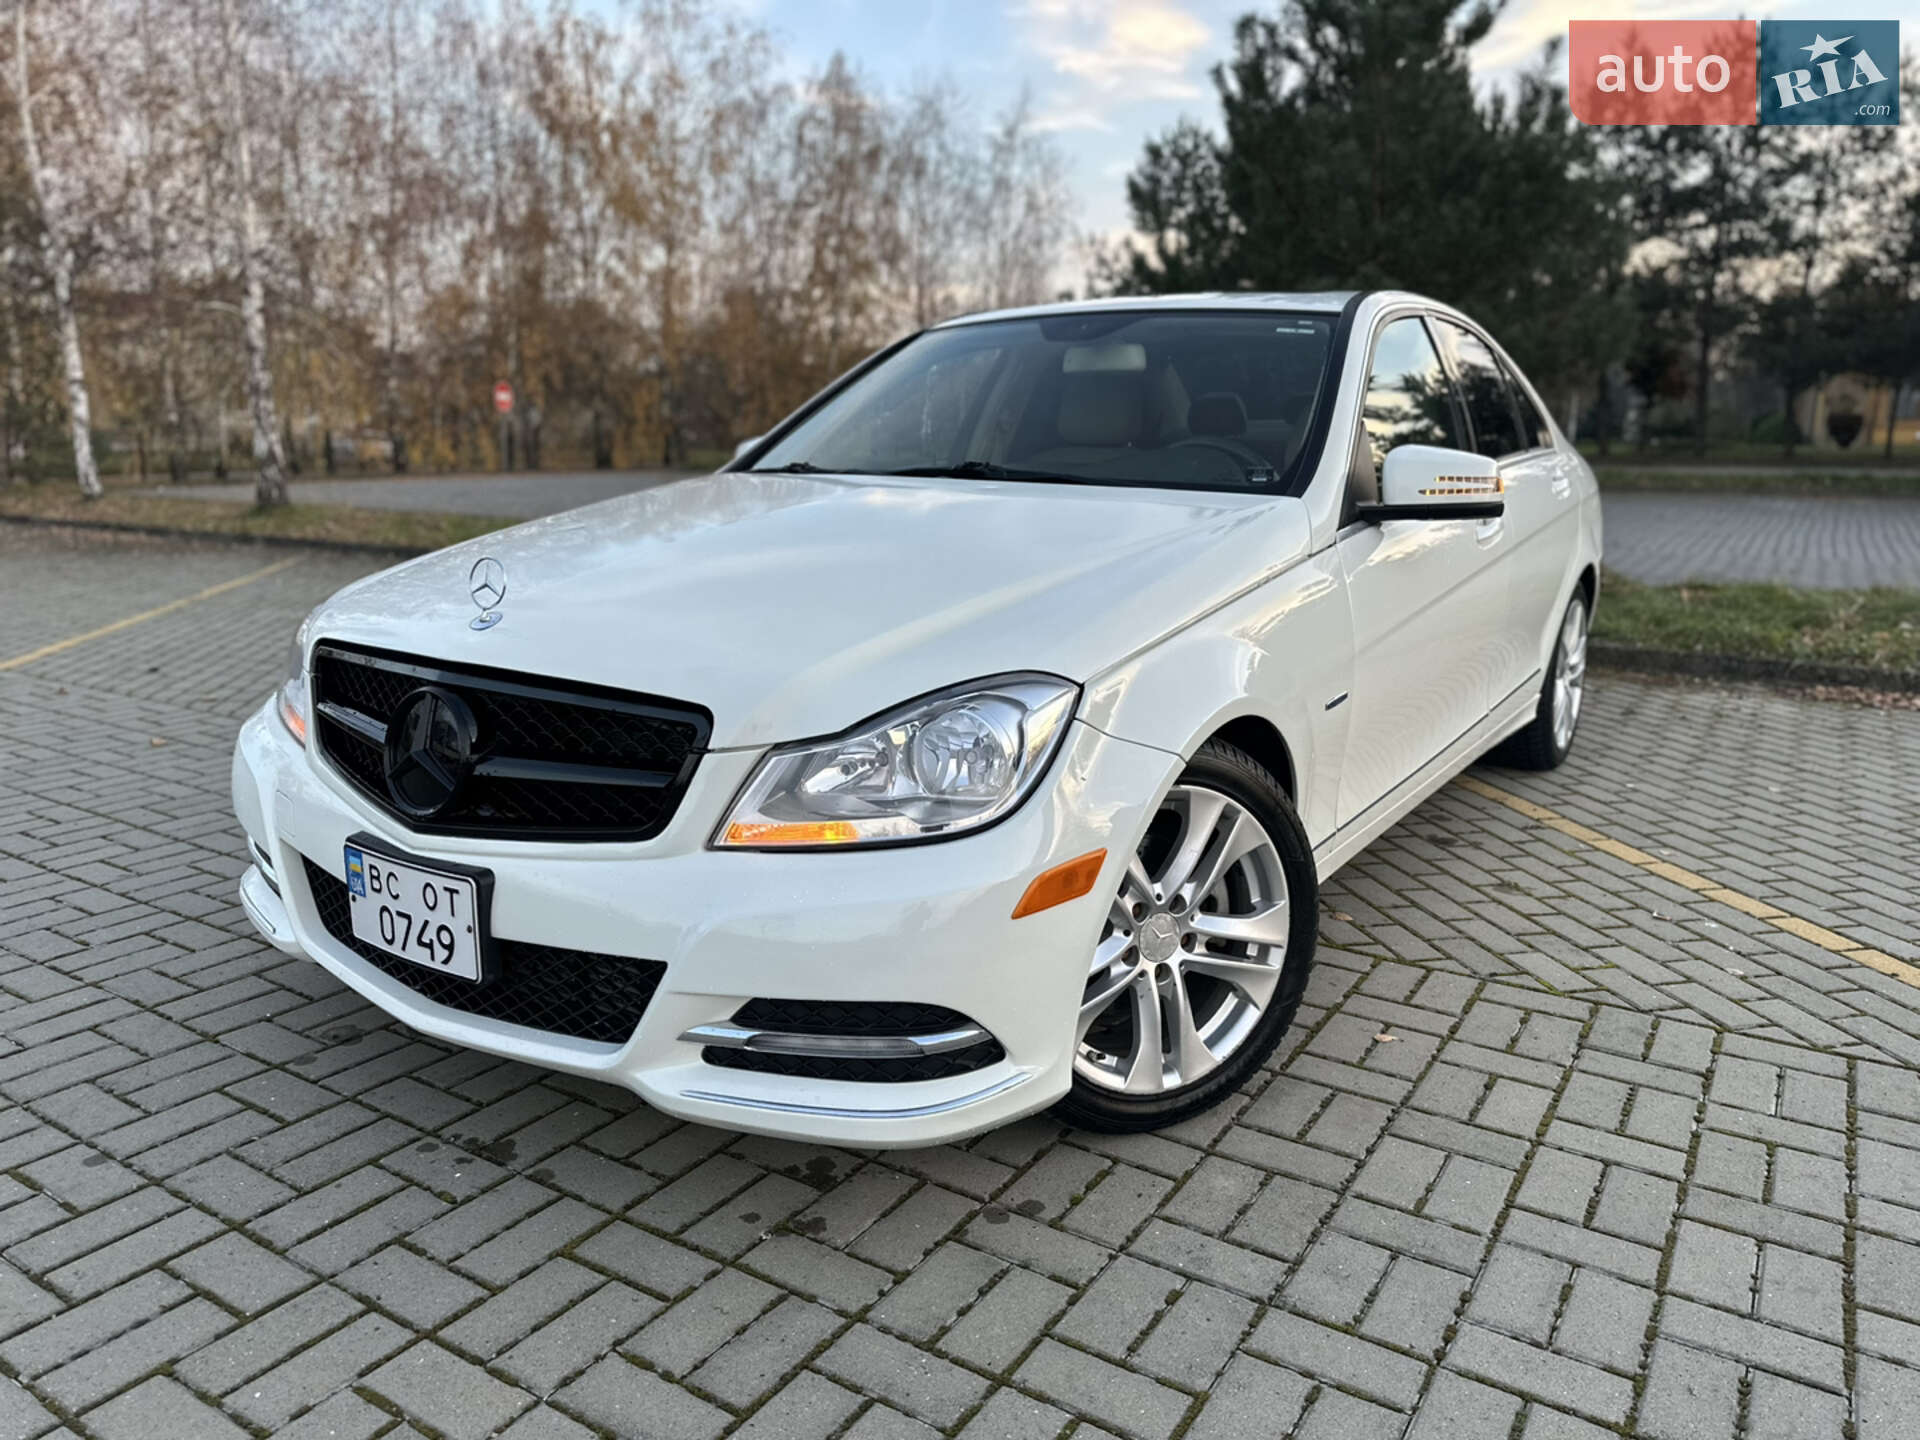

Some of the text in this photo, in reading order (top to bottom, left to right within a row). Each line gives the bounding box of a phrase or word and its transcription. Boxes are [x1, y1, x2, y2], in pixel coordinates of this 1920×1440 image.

[369, 863, 460, 918] BC OT
[379, 905, 455, 965] 0749
